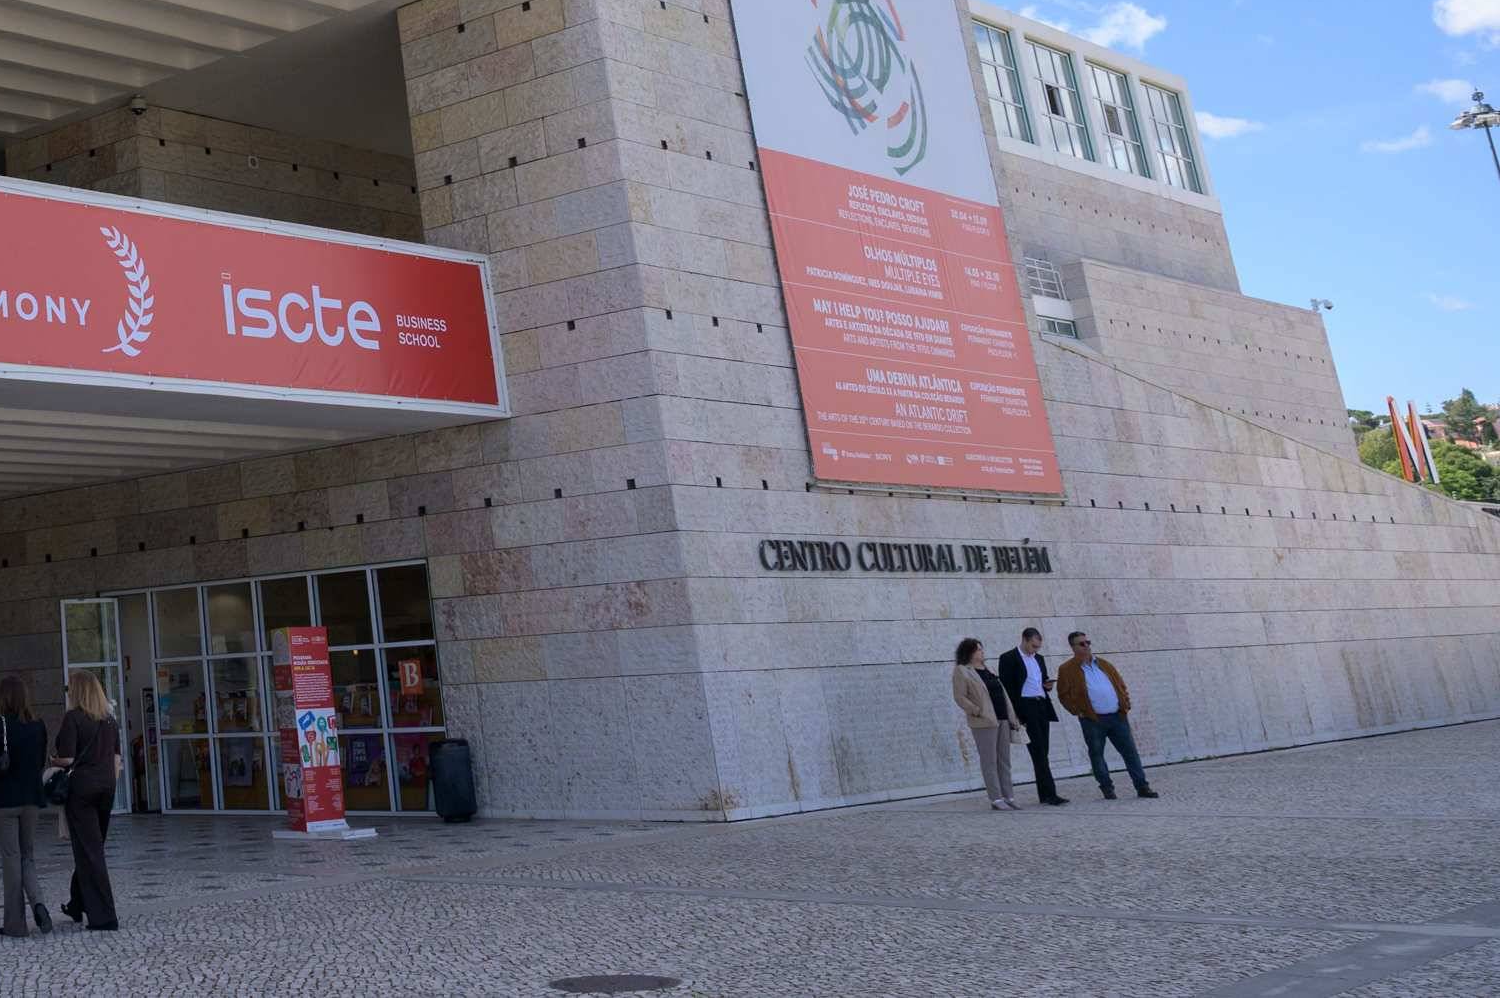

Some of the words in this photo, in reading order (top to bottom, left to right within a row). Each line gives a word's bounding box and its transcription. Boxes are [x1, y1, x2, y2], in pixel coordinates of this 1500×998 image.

[848, 185, 869, 200] JOSÉ
[869, 189, 897, 207] PEDRO
[898, 196, 924, 214] CROFT
[864, 246, 893, 263] OLHOS
[893, 250, 937, 272] MÚLTIPLOS
[884, 264, 922, 284] MULTIPLE
[921, 272, 940, 288] EYES
[221, 272, 381, 350] iscte
[396, 314, 447, 333] BUSINESS
[813, 298, 831, 314] MAY
[838, 303, 861, 318] HELP
[862, 307, 884, 323] YOU?
[885, 310, 913, 327] POSSO
[914, 315, 949, 334] AJUDAR?
[398, 332, 441, 349] SCHOOL
[866, 368, 887, 384] UMA
[886, 371, 918, 387] DERIVA
[919, 374, 963, 393] ATLÂNTICA
[896, 402, 907, 417] AN
[908, 404, 946, 421] ATLANTIC
[945, 408, 968, 422] DRIFT
[759, 540, 850, 572] CENTRO
[856, 541, 963, 573] CULTURAL
[962, 544, 990, 573] DE
[991, 537, 1053, 573] BELÉM
[404, 662, 419, 687] B
